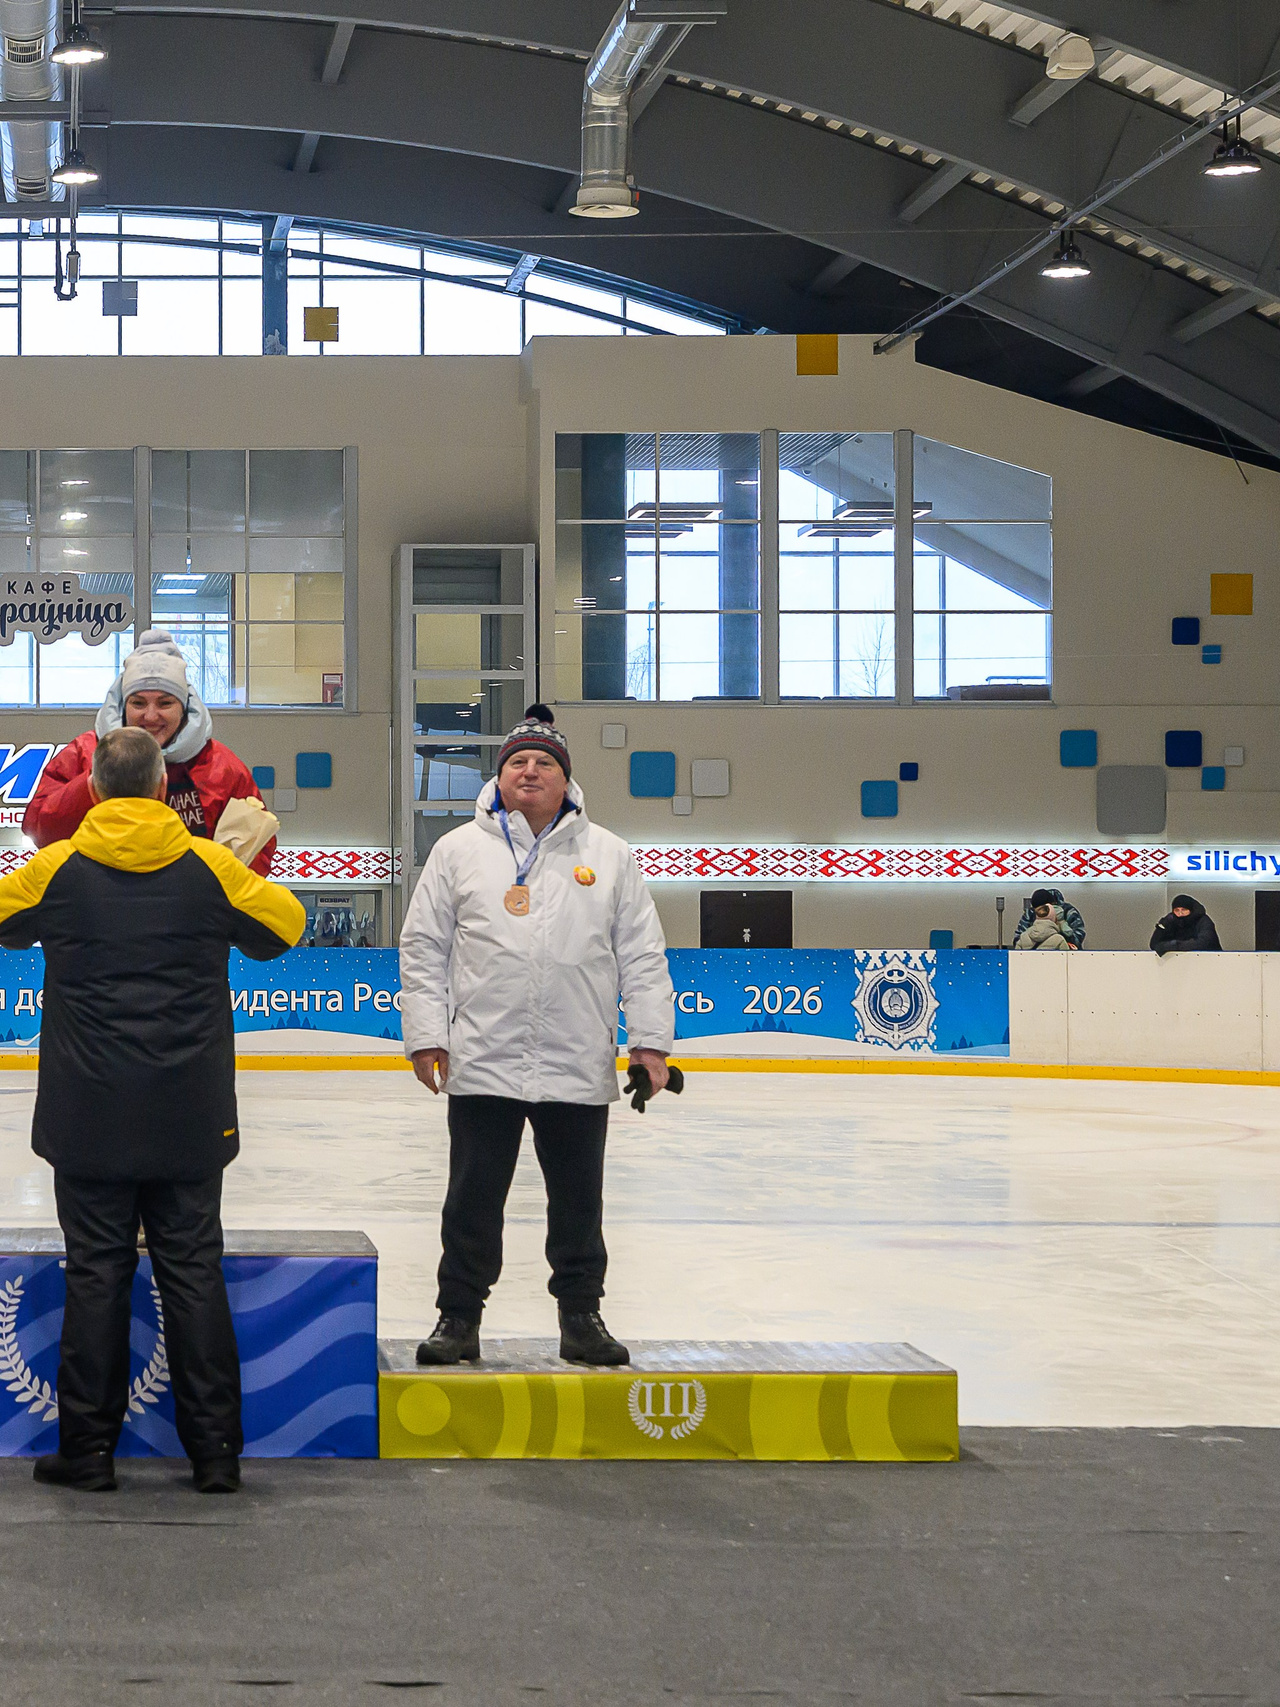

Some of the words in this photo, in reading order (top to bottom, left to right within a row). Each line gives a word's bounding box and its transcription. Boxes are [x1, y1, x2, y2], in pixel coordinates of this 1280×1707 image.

[7, 581, 72, 595] КАФЕ
[742, 984, 824, 1015] 2026
[643, 1382, 694, 1418] III
